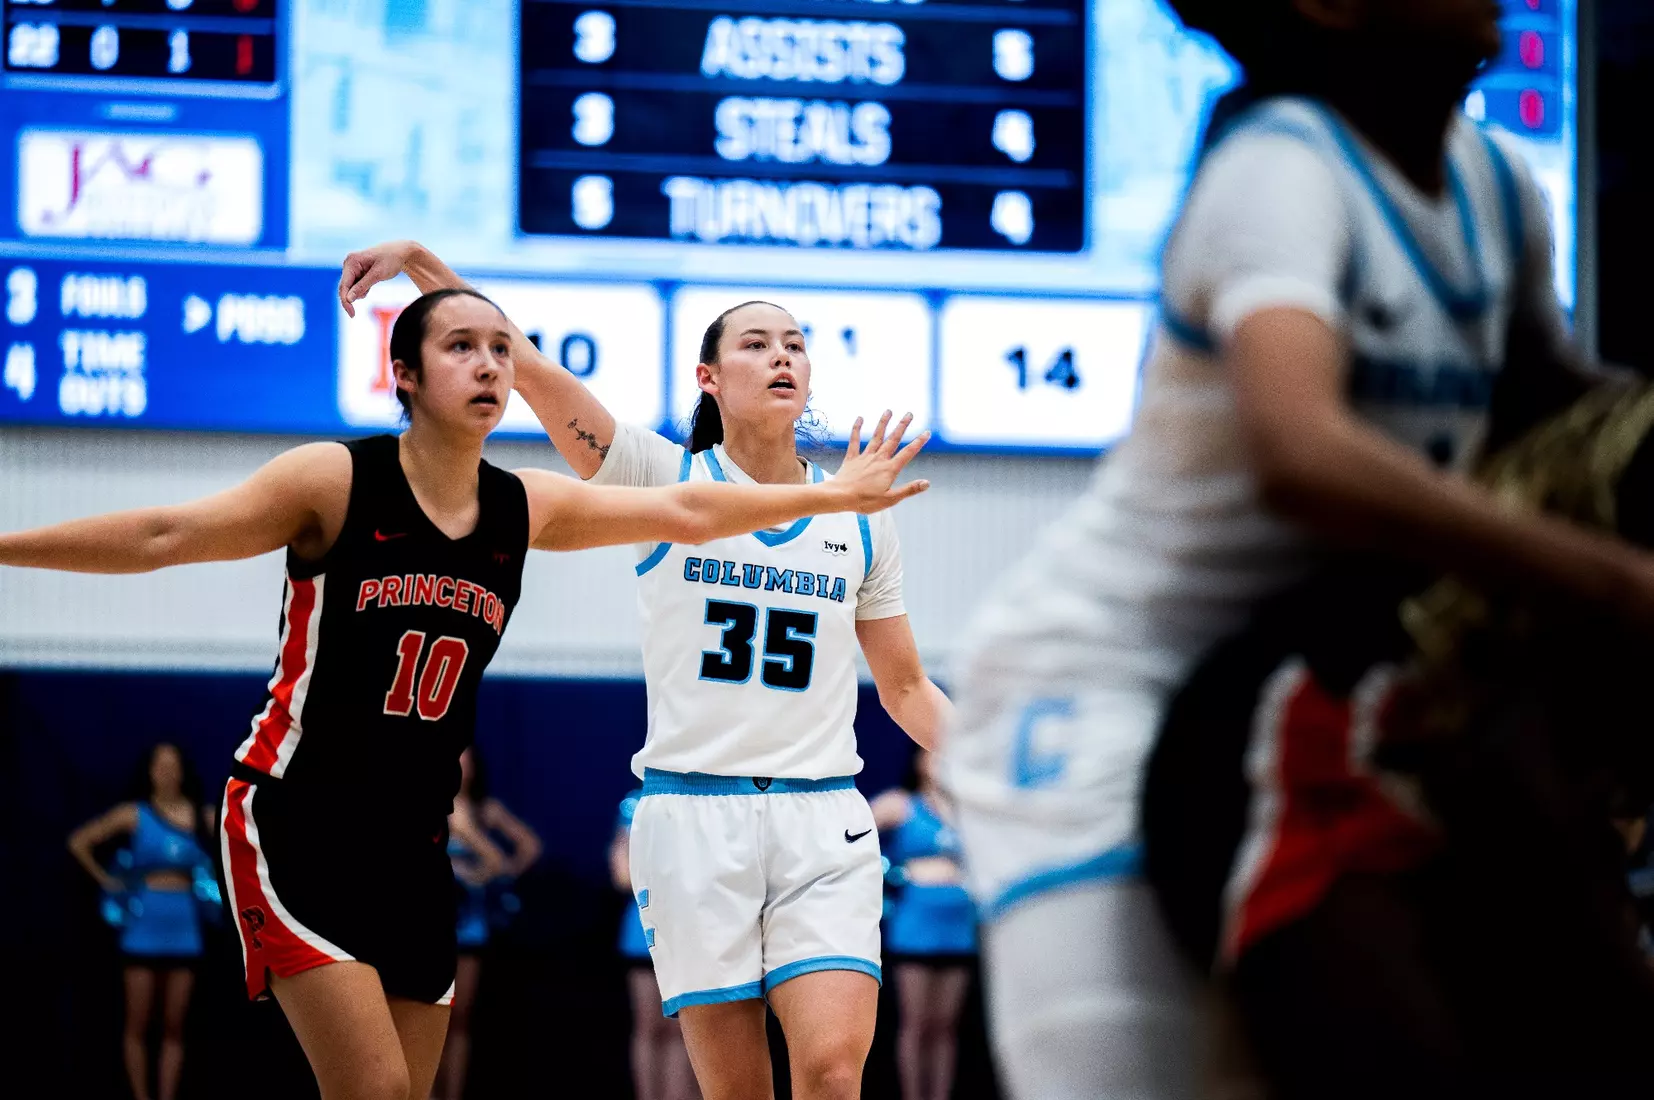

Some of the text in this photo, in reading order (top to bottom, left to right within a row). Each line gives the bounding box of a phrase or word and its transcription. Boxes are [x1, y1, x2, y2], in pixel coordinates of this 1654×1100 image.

[573, 11, 616, 63] 3
[702, 16, 905, 85] ASSISTS
[572, 93, 615, 146] 3
[714, 96, 892, 166] STEALS
[661, 176, 942, 249] TURNOVERS
[7, 267, 37, 325] 3
[60, 330, 147, 373] TIME
[1005, 345, 1082, 392] 14
[59, 373, 148, 418] OUTS
[824, 540, 840, 553] Ivy
[355, 573, 505, 636] PRINCETON
[683, 556, 847, 602] COLUMBIA
[383, 629, 469, 721] 10
[698, 598, 819, 693] 35
[1010, 696, 1078, 790] C
